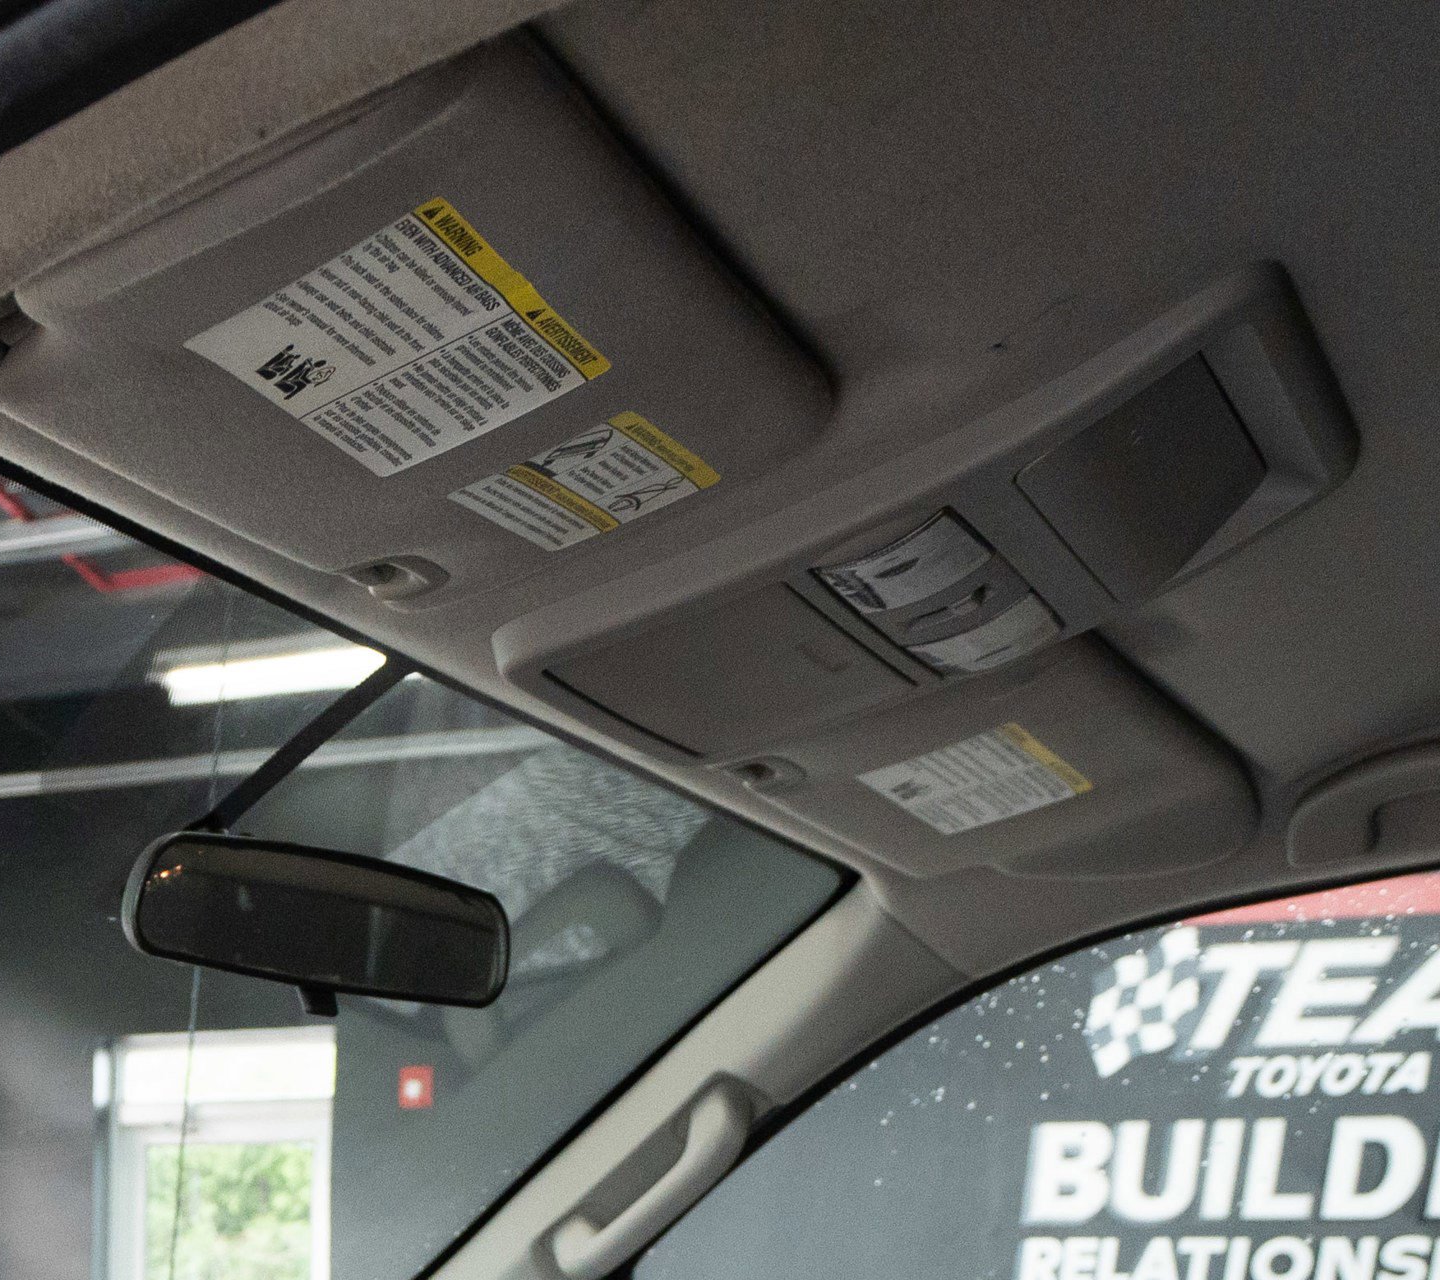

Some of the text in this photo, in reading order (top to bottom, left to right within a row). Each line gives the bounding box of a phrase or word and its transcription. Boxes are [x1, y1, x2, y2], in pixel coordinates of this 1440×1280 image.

[432, 213, 484, 257] WARNING
[393, 217, 501, 312] EVEN WITH ADVANCED AIR BAGS
[536, 314, 598, 367] AVERTISSEMENT
[1225, 1051, 1431, 1099] TOYOTA
